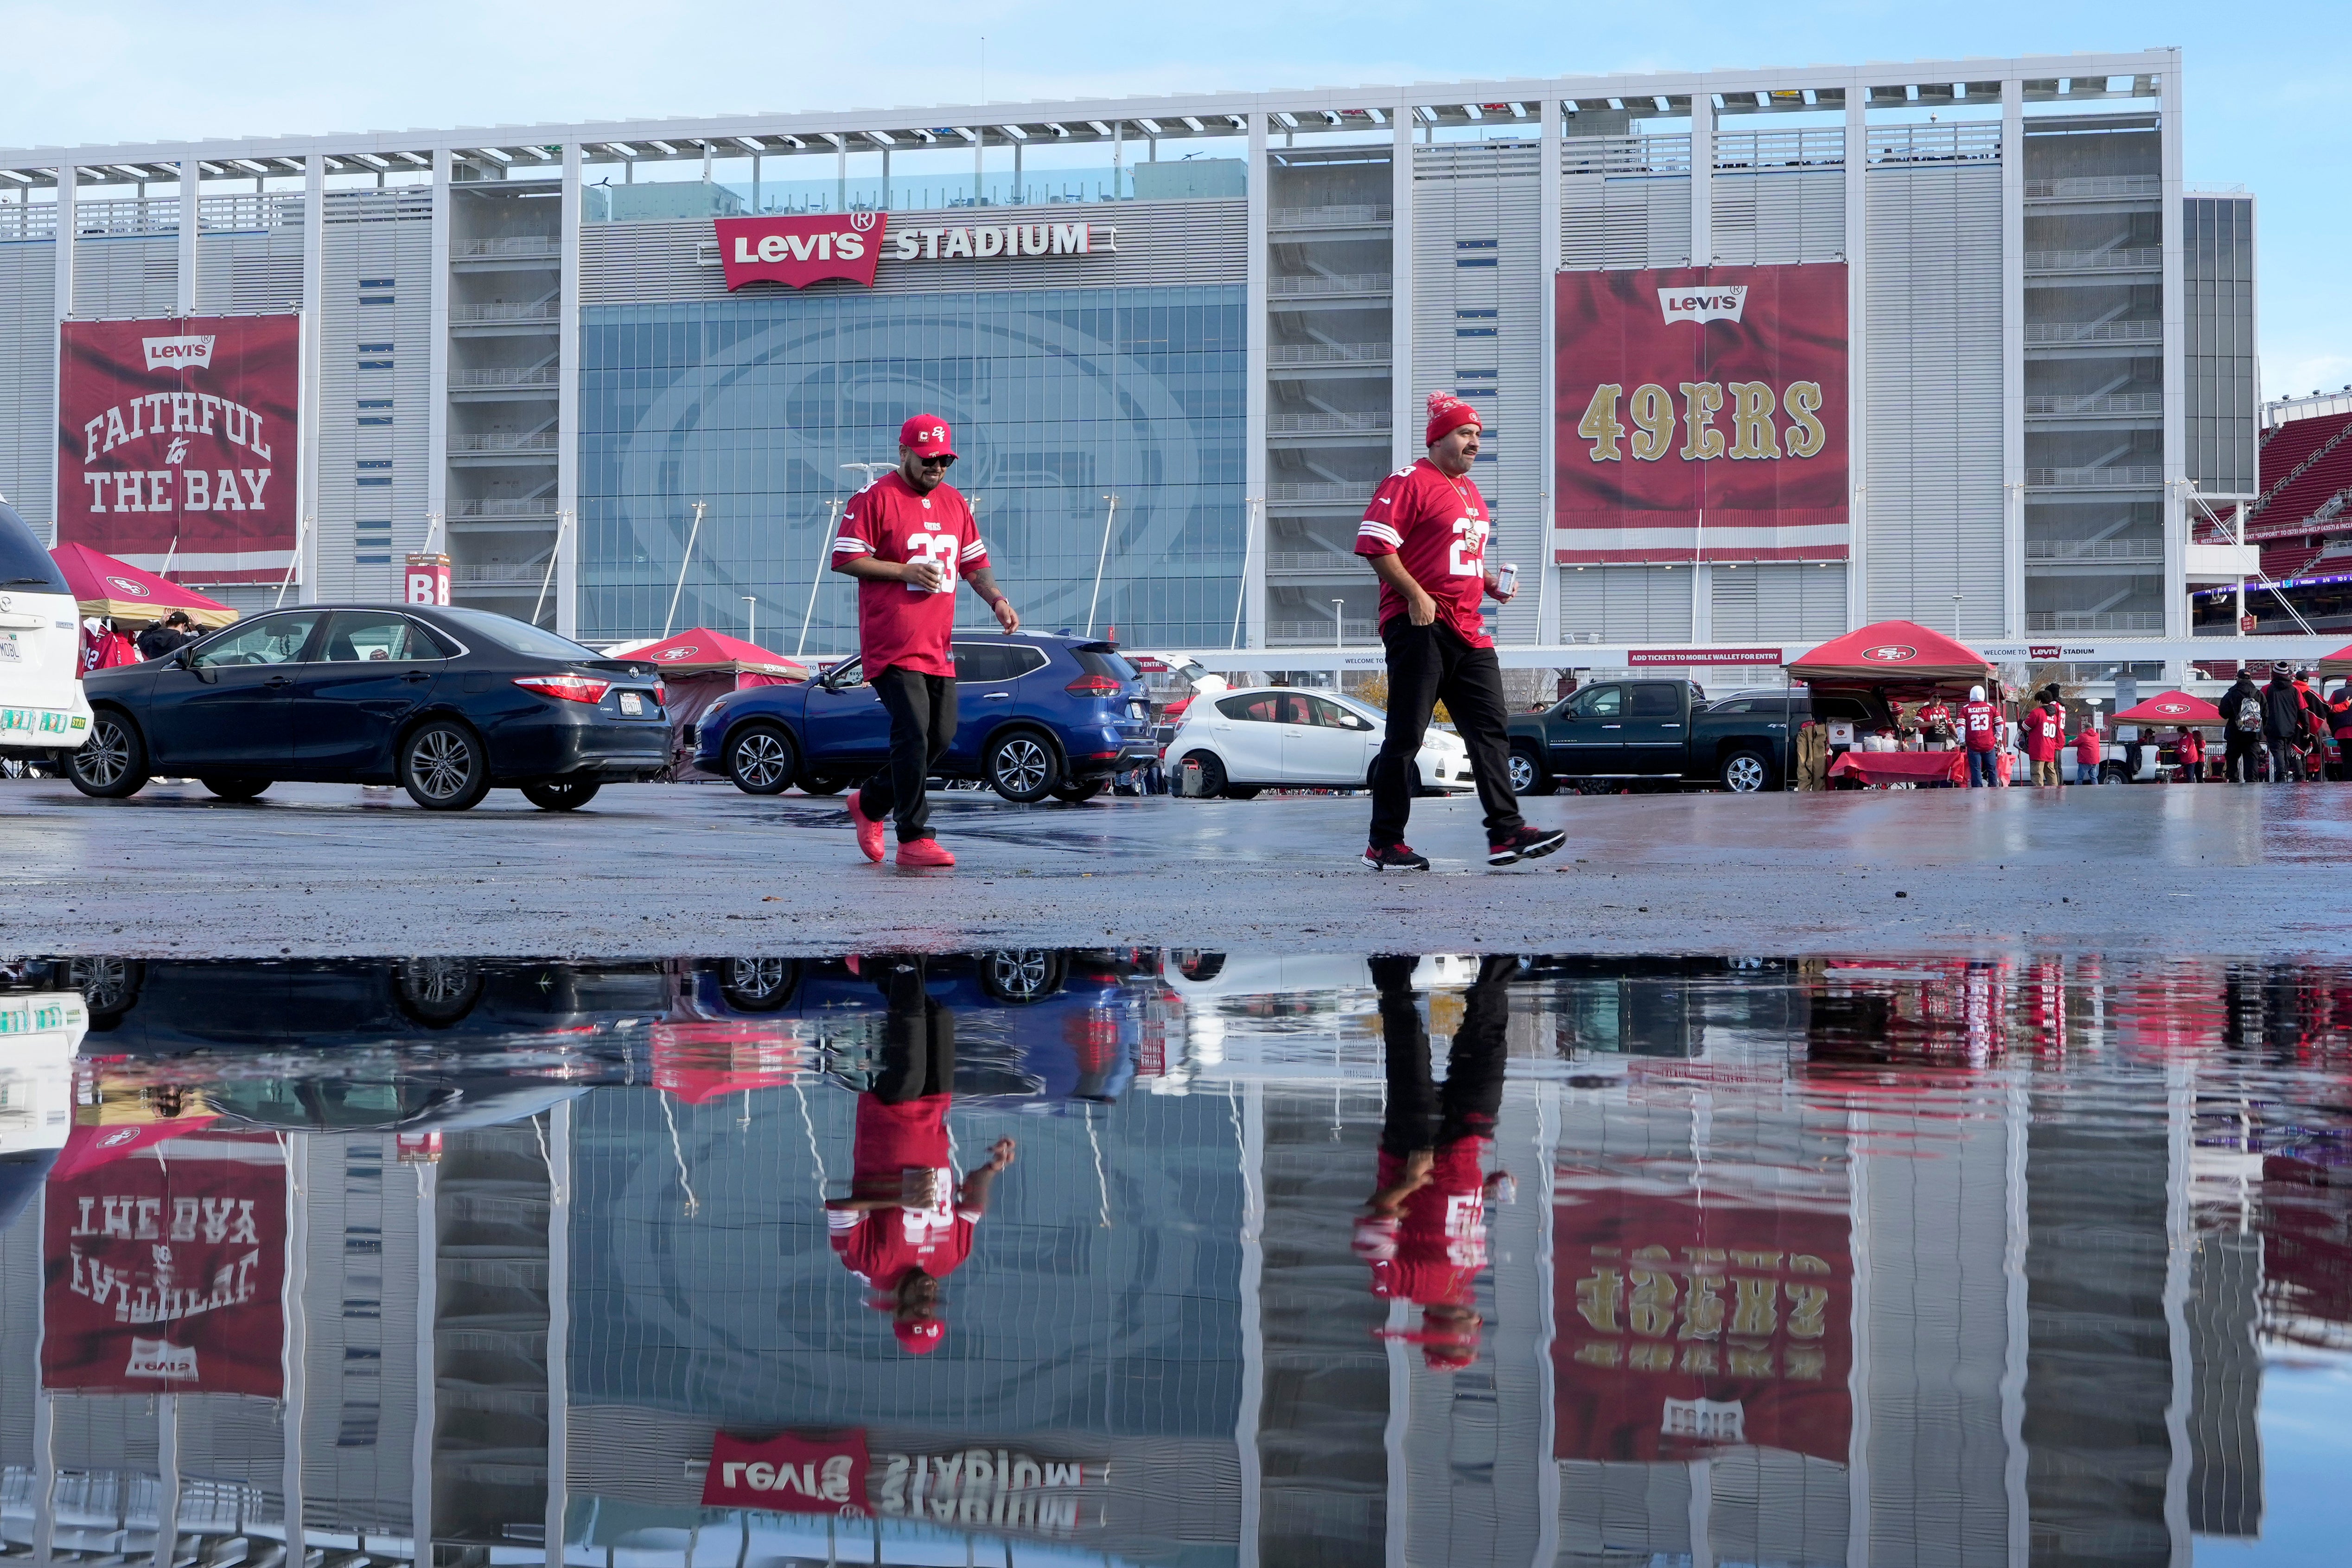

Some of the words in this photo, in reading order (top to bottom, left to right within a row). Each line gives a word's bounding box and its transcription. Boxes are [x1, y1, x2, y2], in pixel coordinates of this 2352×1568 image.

[897, 223, 1090, 261] STADIUM
[84, 392, 272, 465] FAITHFUL
[920, 431, 928, 440] C
[931, 426, 945, 442] SF
[1578, 382, 1826, 461] 49ERS
[165, 437, 189, 465] to
[84, 471, 172, 513] THE
[184, 469, 271, 511] BAY
[1449, 517, 1490, 579] 23
[906, 533, 958, 593] 23
[408, 574, 434, 605] B
[438, 574, 449, 606] B
[85, 647, 100, 670] 12
[763, 663, 787, 673] 49ERS
[72, 718, 85, 727] STAY
[1970, 714, 1989, 731] 23
[2042, 722, 2056, 738] 80
